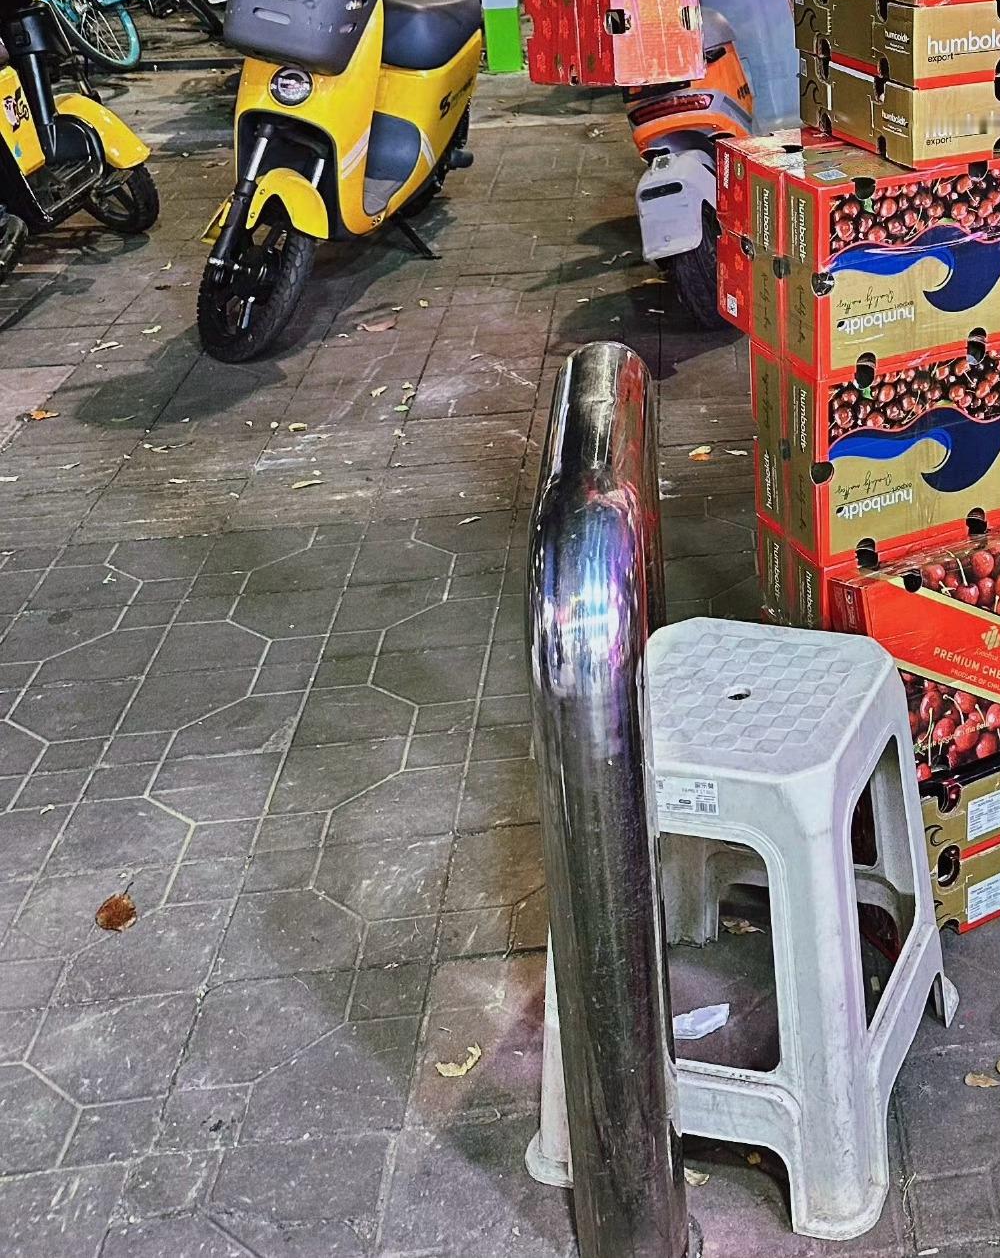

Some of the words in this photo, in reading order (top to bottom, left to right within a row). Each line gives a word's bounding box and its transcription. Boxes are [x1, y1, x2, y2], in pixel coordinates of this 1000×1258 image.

[927, 52, 954, 62] export
[926, 135, 952, 145] export
[762, 188, 770, 251] humboldt
[798, 198, 806, 264] humboldt
[837, 305, 914, 334] humboldt
[799, 388, 807, 453] humboldt
[763, 450, 773, 510] humboldt
[836, 489, 913, 520] humboldt
[773, 542, 781, 602] humboldt
[933, 647, 980, 672] PREMIUM
[951, 668, 977, 682] PRODUCE
